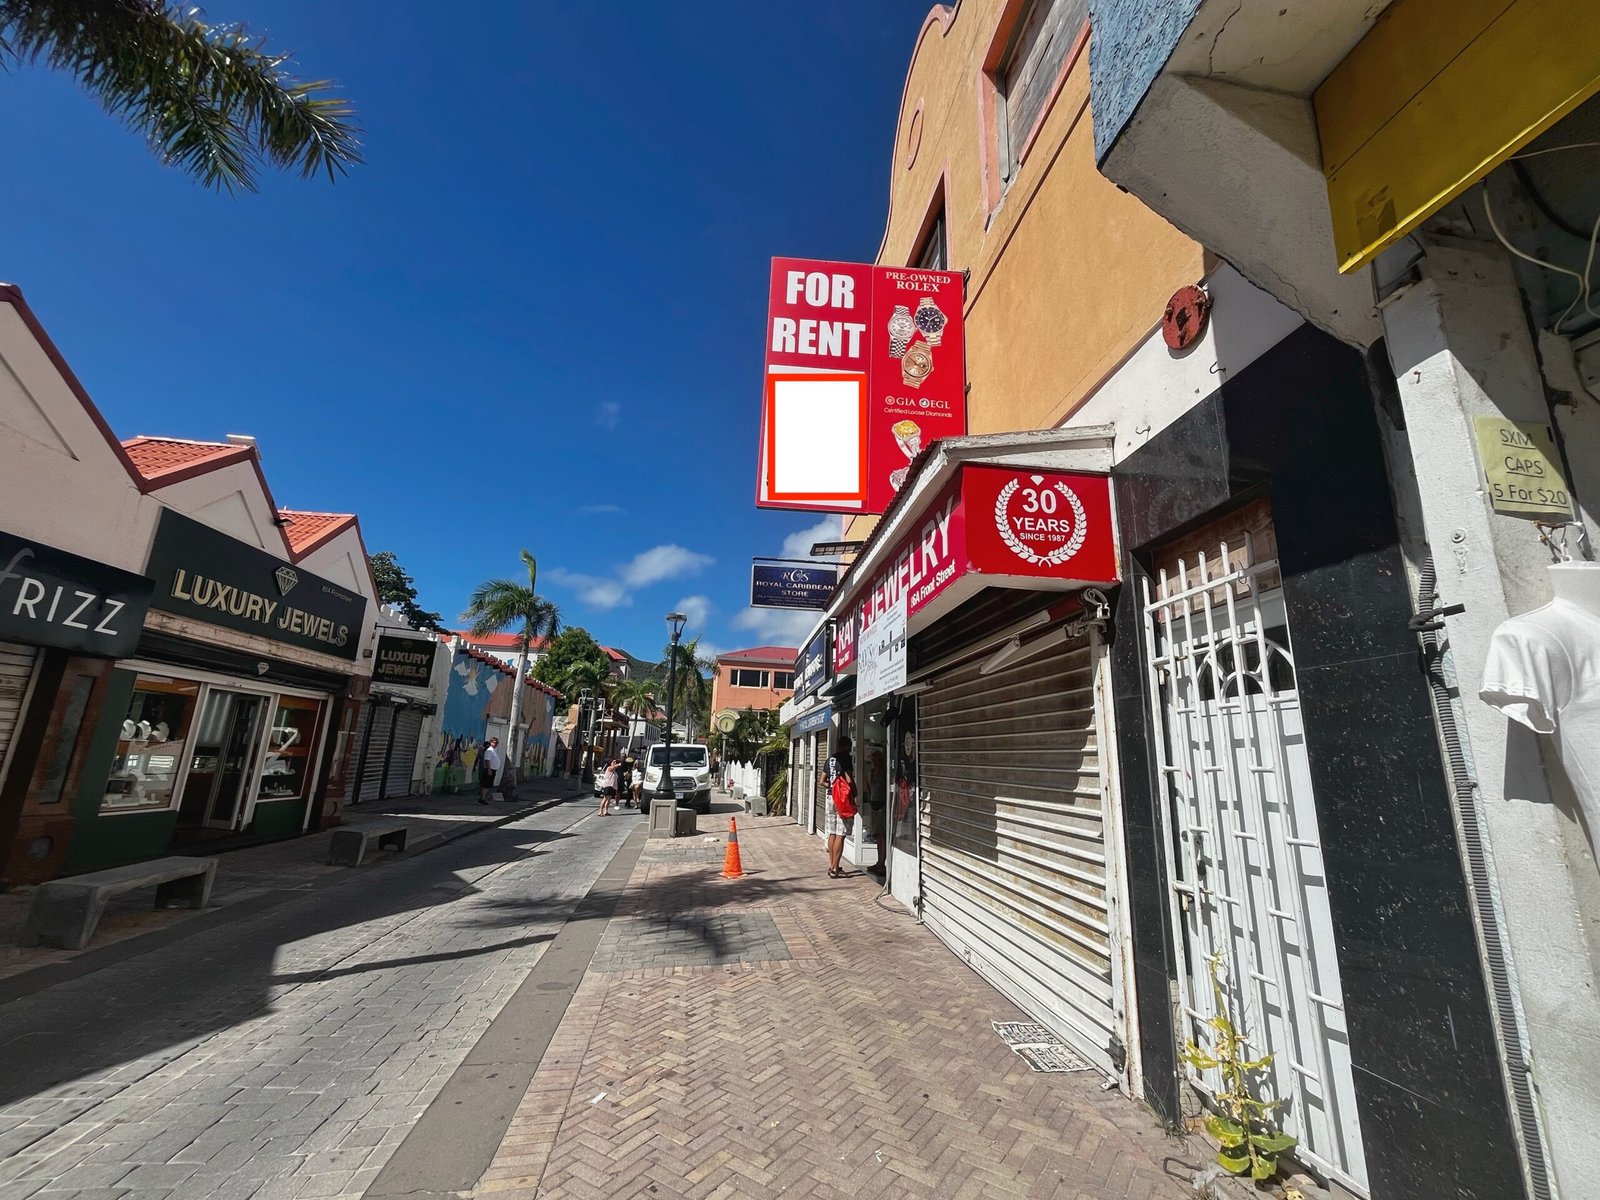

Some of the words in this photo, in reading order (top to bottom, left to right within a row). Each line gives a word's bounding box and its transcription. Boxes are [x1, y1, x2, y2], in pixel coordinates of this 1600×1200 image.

[885, 271, 951, 285] PRE-OWNED
[896, 281, 940, 292] ROLEX
[786, 270, 855, 309] FOR
[771, 316, 867, 359] RENT
[896, 397, 916, 407] GIA
[930, 400, 951, 409] EGL
[1499, 428, 1535, 446] SXM
[1504, 456, 1544, 475] CAPS
[1021, 488, 1058, 514] 30
[1493, 483, 1504, 498] 5
[1508, 484, 1533, 501] For
[1537, 486, 1568, 506] $20
[1012, 516, 1071, 533] YEARS
[1019, 532, 1046, 542] SINCE
[1047, 533, 1066, 543] 1987
[868, 497, 954, 625] JEWELRY
[935, 559, 956, 587] Street
[756, 580, 785, 588] ROYAL
[786, 583, 835, 592] CARIBBEAN
[171, 568, 276, 625] LUXURY
[276, 606, 349, 648] JEWELS
[380, 649, 430, 665] LUXURY
[377, 663, 428, 679] JEWELS
